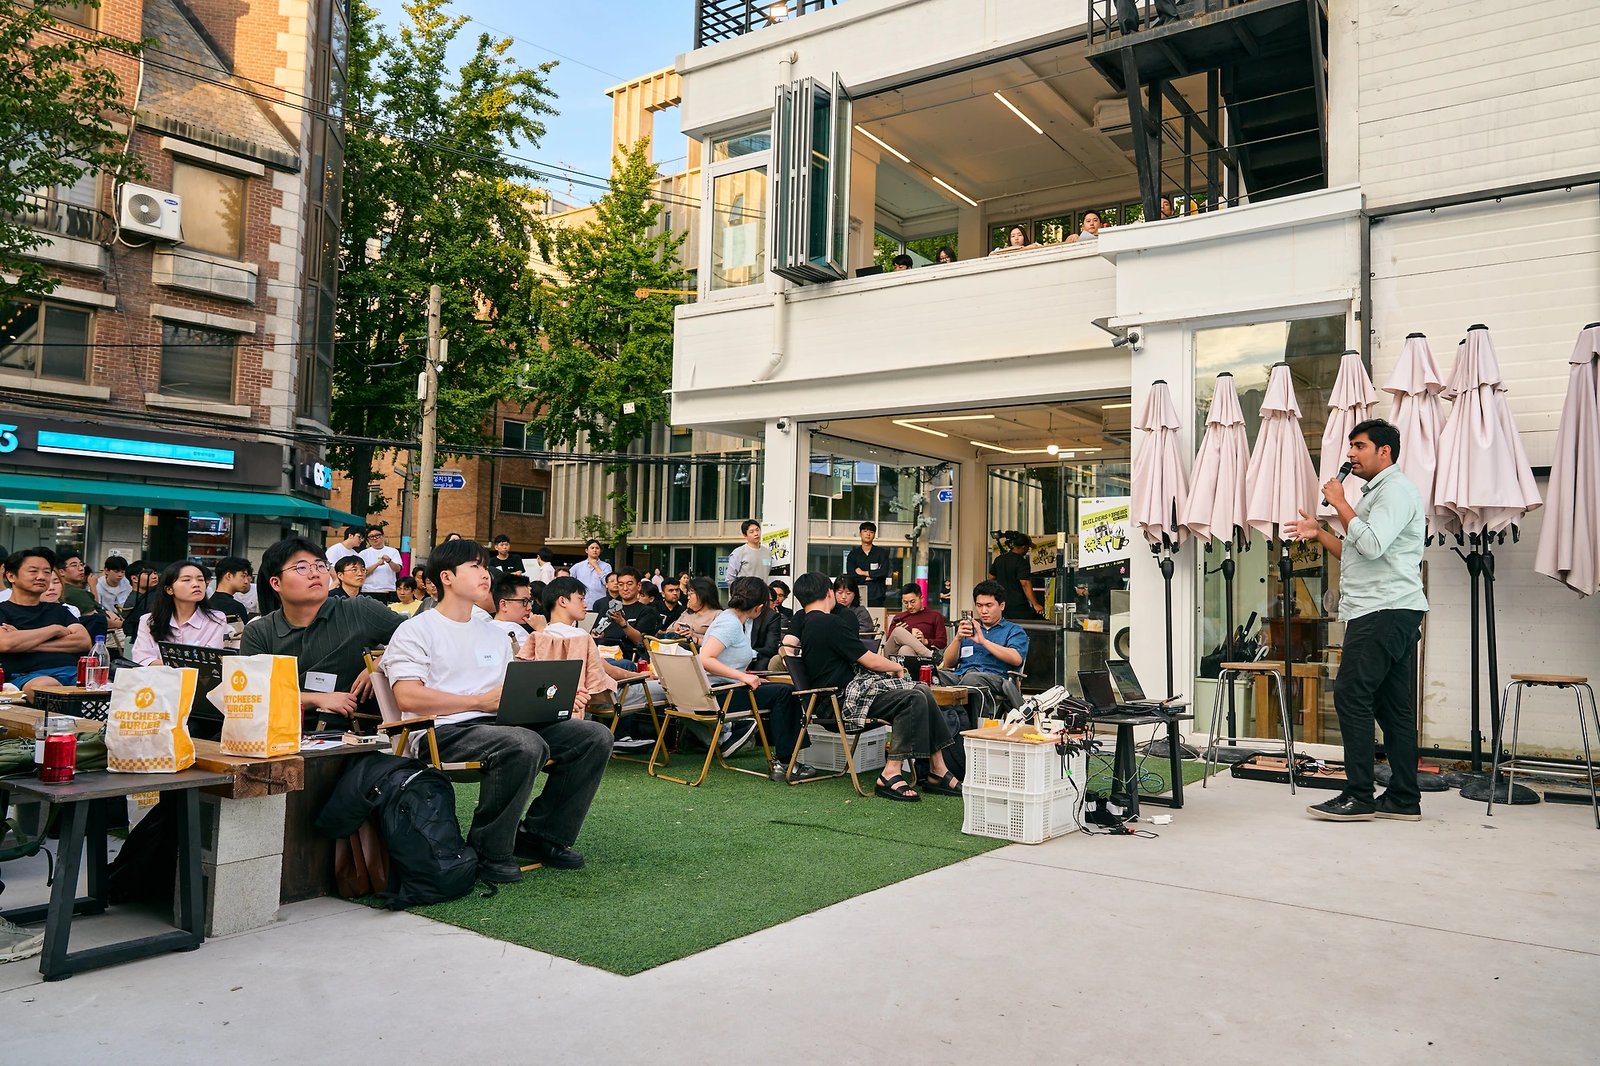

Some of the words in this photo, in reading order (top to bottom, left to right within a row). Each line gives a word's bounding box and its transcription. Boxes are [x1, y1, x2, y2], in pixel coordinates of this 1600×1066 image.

[314, 462, 332, 490] GS25
[833, 468, 850, 479] 임대
[114, 710, 171, 721] CRYCHEESE
[119, 720, 161, 730] BURGER
